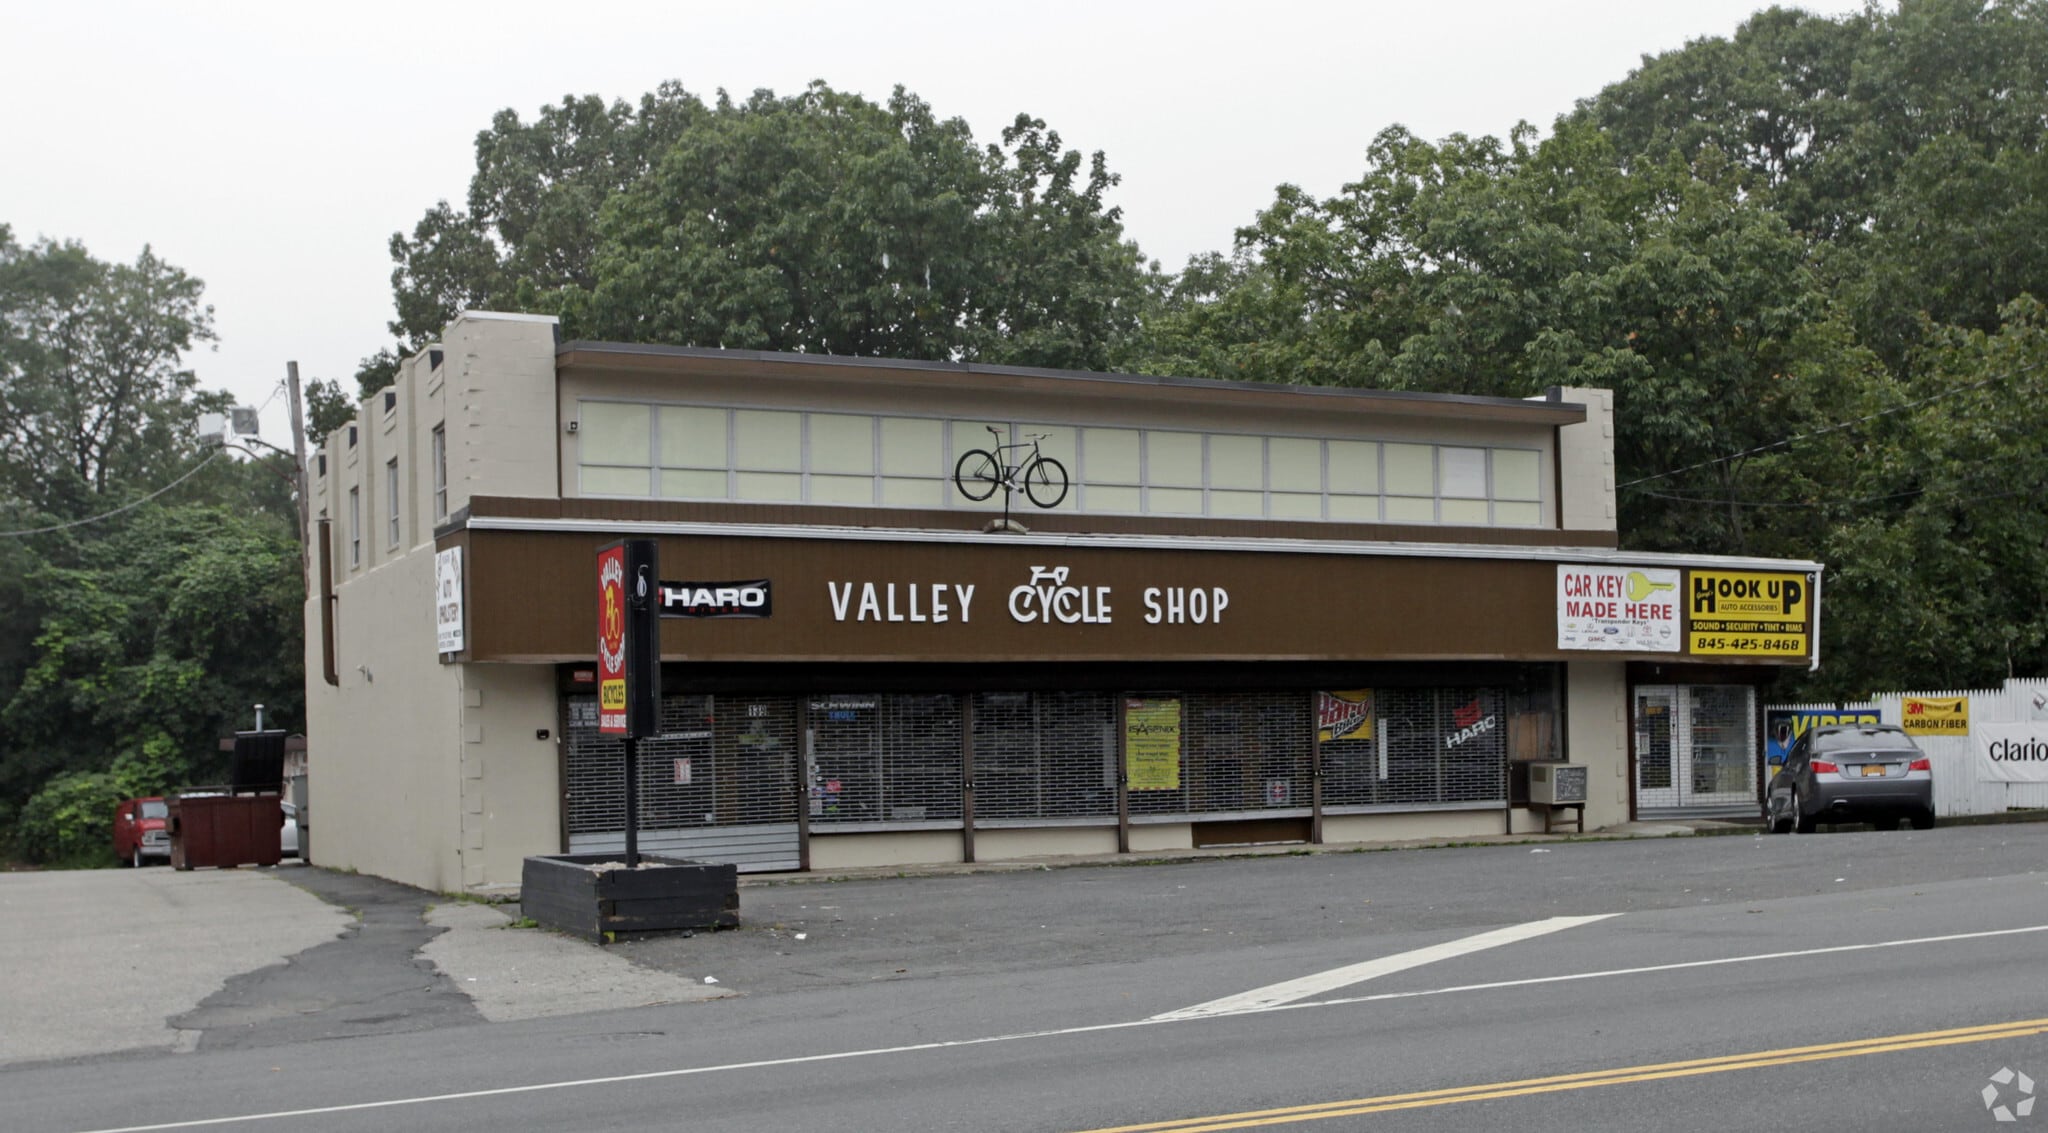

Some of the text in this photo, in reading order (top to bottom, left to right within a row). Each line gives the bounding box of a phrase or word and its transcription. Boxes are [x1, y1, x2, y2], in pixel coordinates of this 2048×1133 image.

[601, 557, 623, 592] VALLEY
[1564, 573, 1624, 599] CAR KEY
[1694, 577, 1802, 615] HOOK UP
[664, 587, 765, 607] HARO
[828, 581, 1229, 624] VALLEY CYCLE SHOP
[1566, 601, 1673, 621] MADE HERE
[1720, 603, 1778, 612] AUTO ACCESSORIES
[1693, 621, 1803, 633] SOUND SECURITY TINT RIMS
[1697, 637, 1800, 650] 845-425-8468
[603, 684, 624, 705] BICYCLES
[1906, 702, 1924, 715] 3M
[1446, 714, 1496, 749] HARO
[1903, 719, 1967, 729] CARBON FIBER
